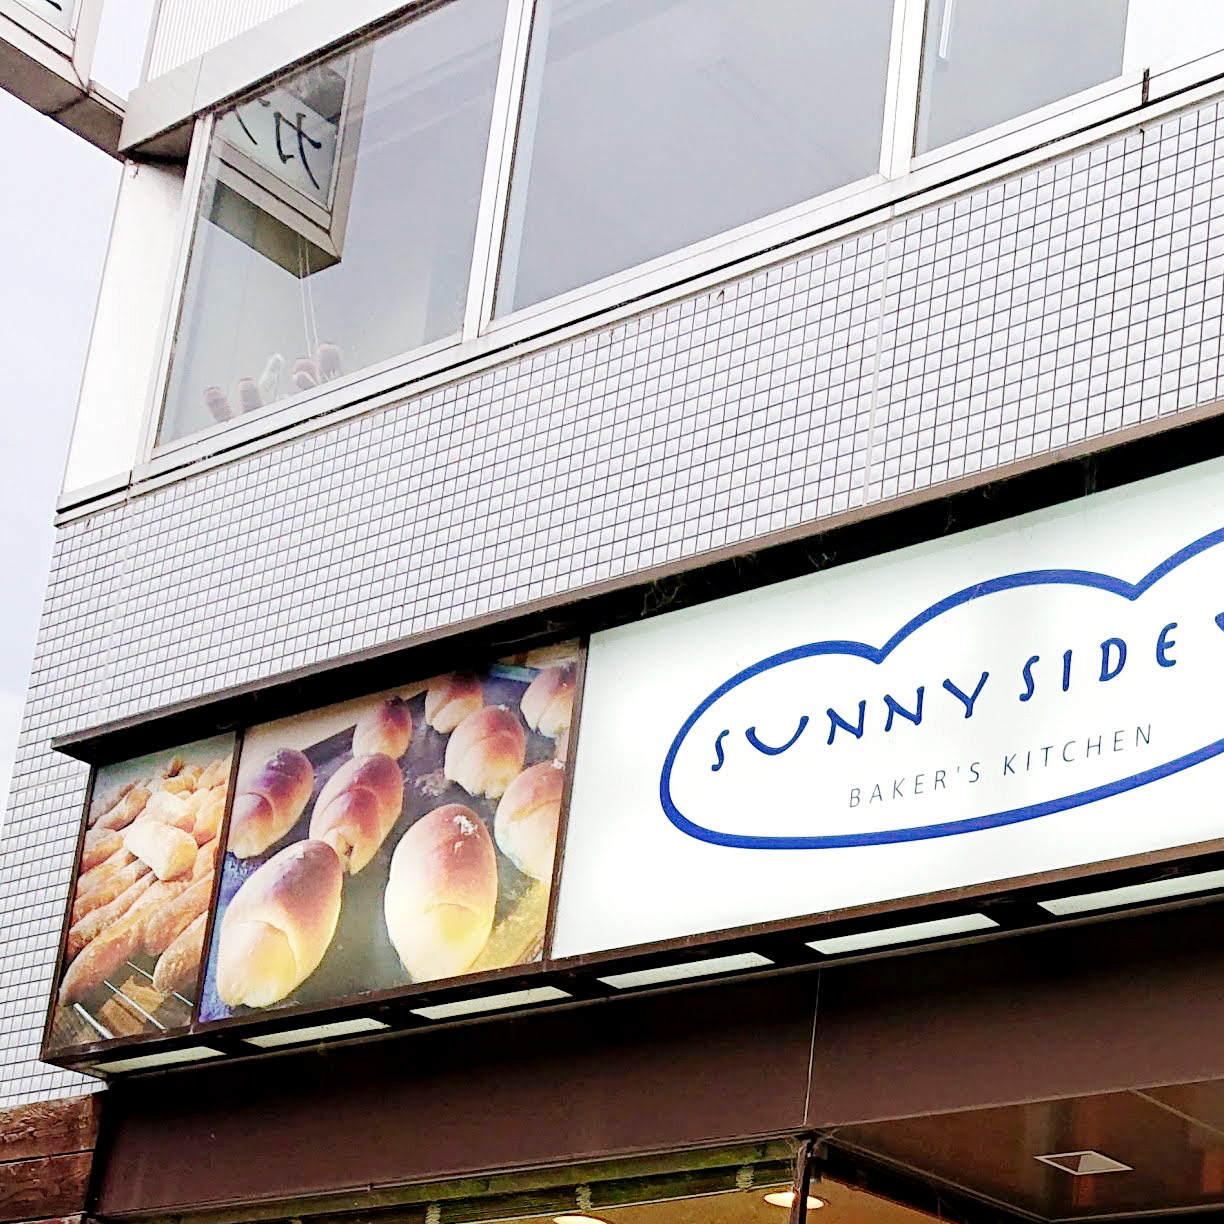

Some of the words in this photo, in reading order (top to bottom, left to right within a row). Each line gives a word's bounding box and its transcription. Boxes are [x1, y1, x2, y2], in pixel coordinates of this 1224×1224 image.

[711, 672, 989, 772] SUNNY
[1019, 621, 1178, 701] SIDE
[849, 762, 981, 808] BAKER'S
[1003, 724, 1154, 775] KITCHEN
